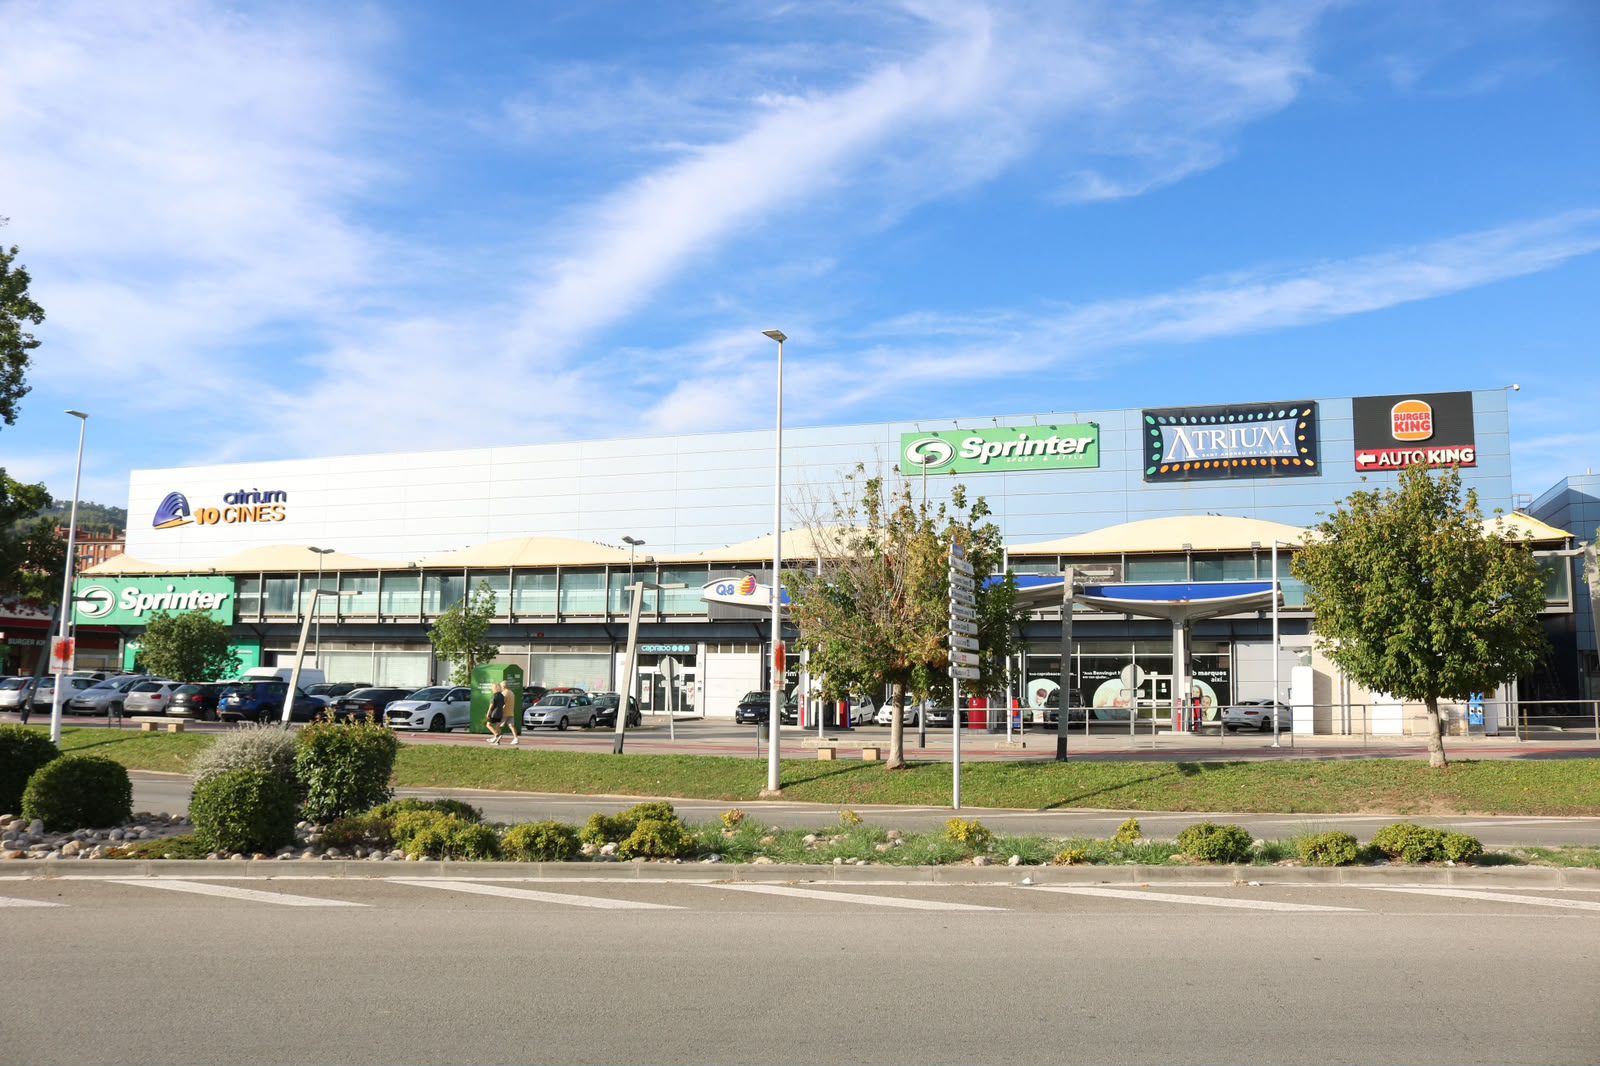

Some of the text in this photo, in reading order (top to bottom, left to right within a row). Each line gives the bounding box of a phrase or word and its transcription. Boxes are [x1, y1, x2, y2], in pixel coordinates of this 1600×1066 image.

[1394, 413, 1430, 421] BURGER
[1394, 421, 1430, 432] KING
[959, 433, 1094, 464] Sprinter
[1166, 426, 1292, 460] ATRIUM
[1379, 448, 1474, 465] AUTO KING
[193, 505, 286, 525] 10 CINES
[716, 584, 735, 596] Q8
[119, 584, 229, 617] Sprinter
